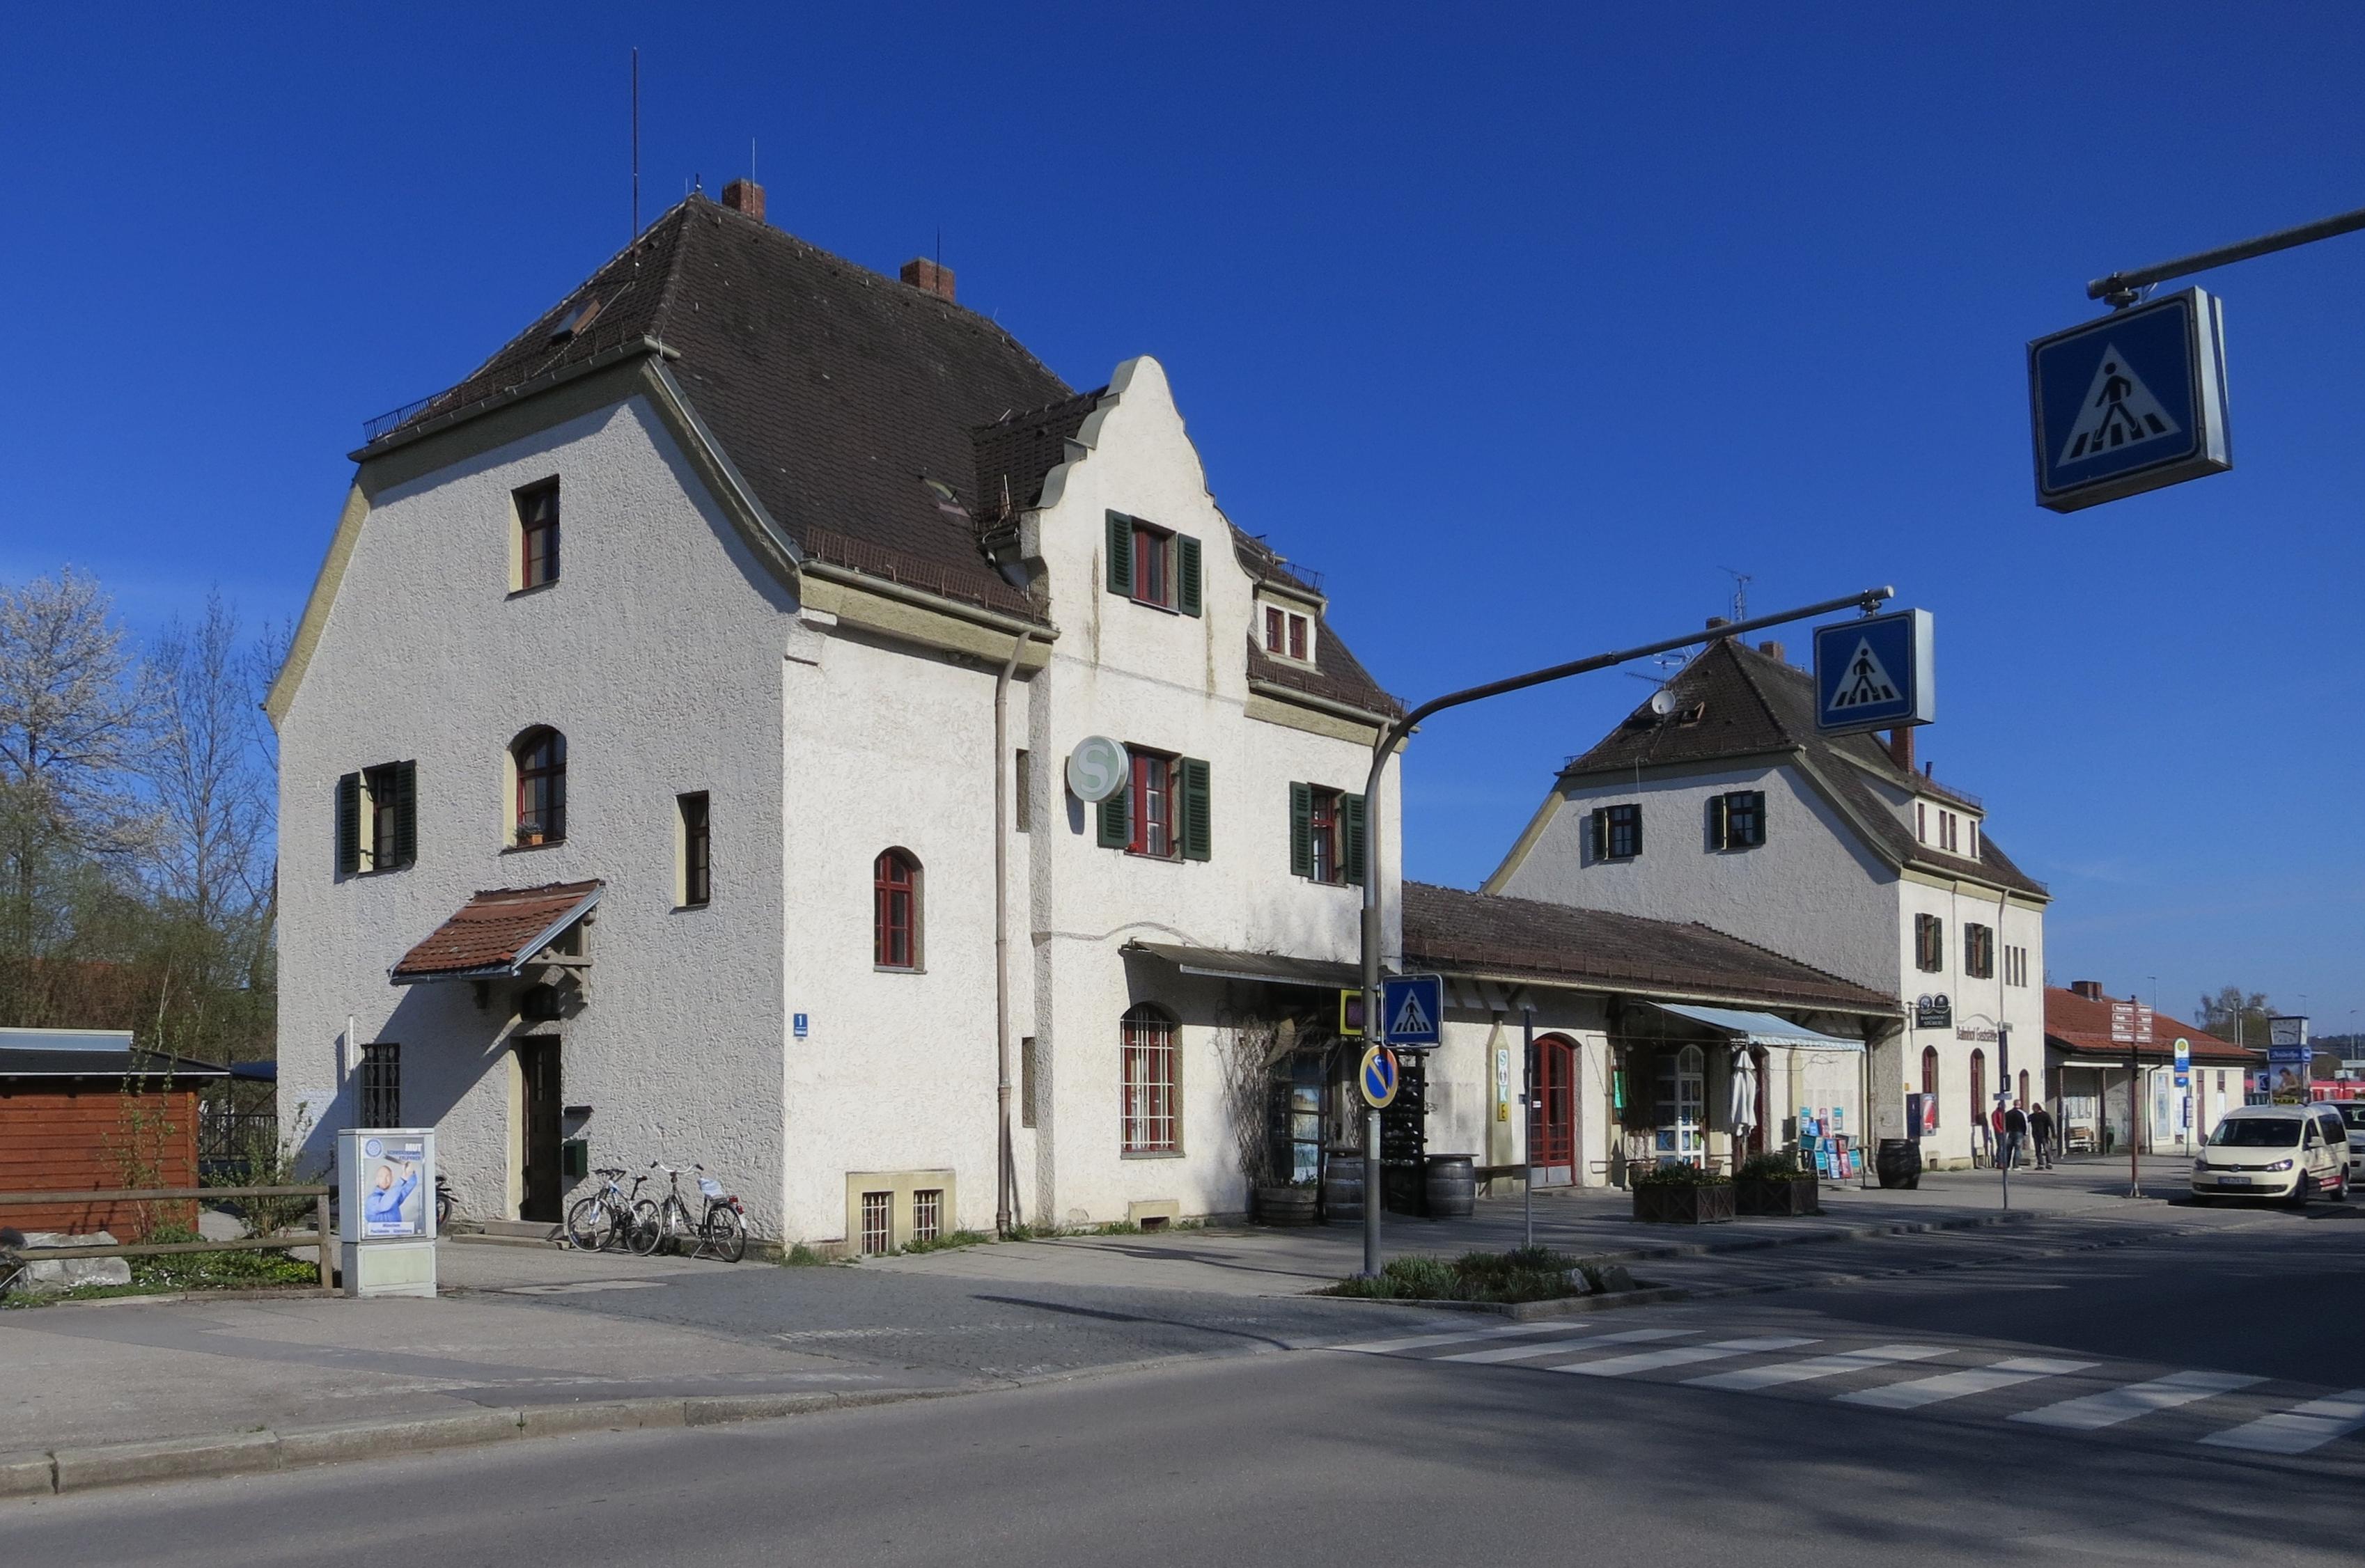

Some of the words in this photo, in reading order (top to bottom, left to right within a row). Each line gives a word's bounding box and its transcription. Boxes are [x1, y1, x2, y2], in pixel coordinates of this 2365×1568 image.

[1077, 744, 1109, 793] S
[798, 1015, 803, 1026] 1
[1956, 1026, 1975, 1041] Bahnhof
[405, 1143, 422, 1152] MUT
